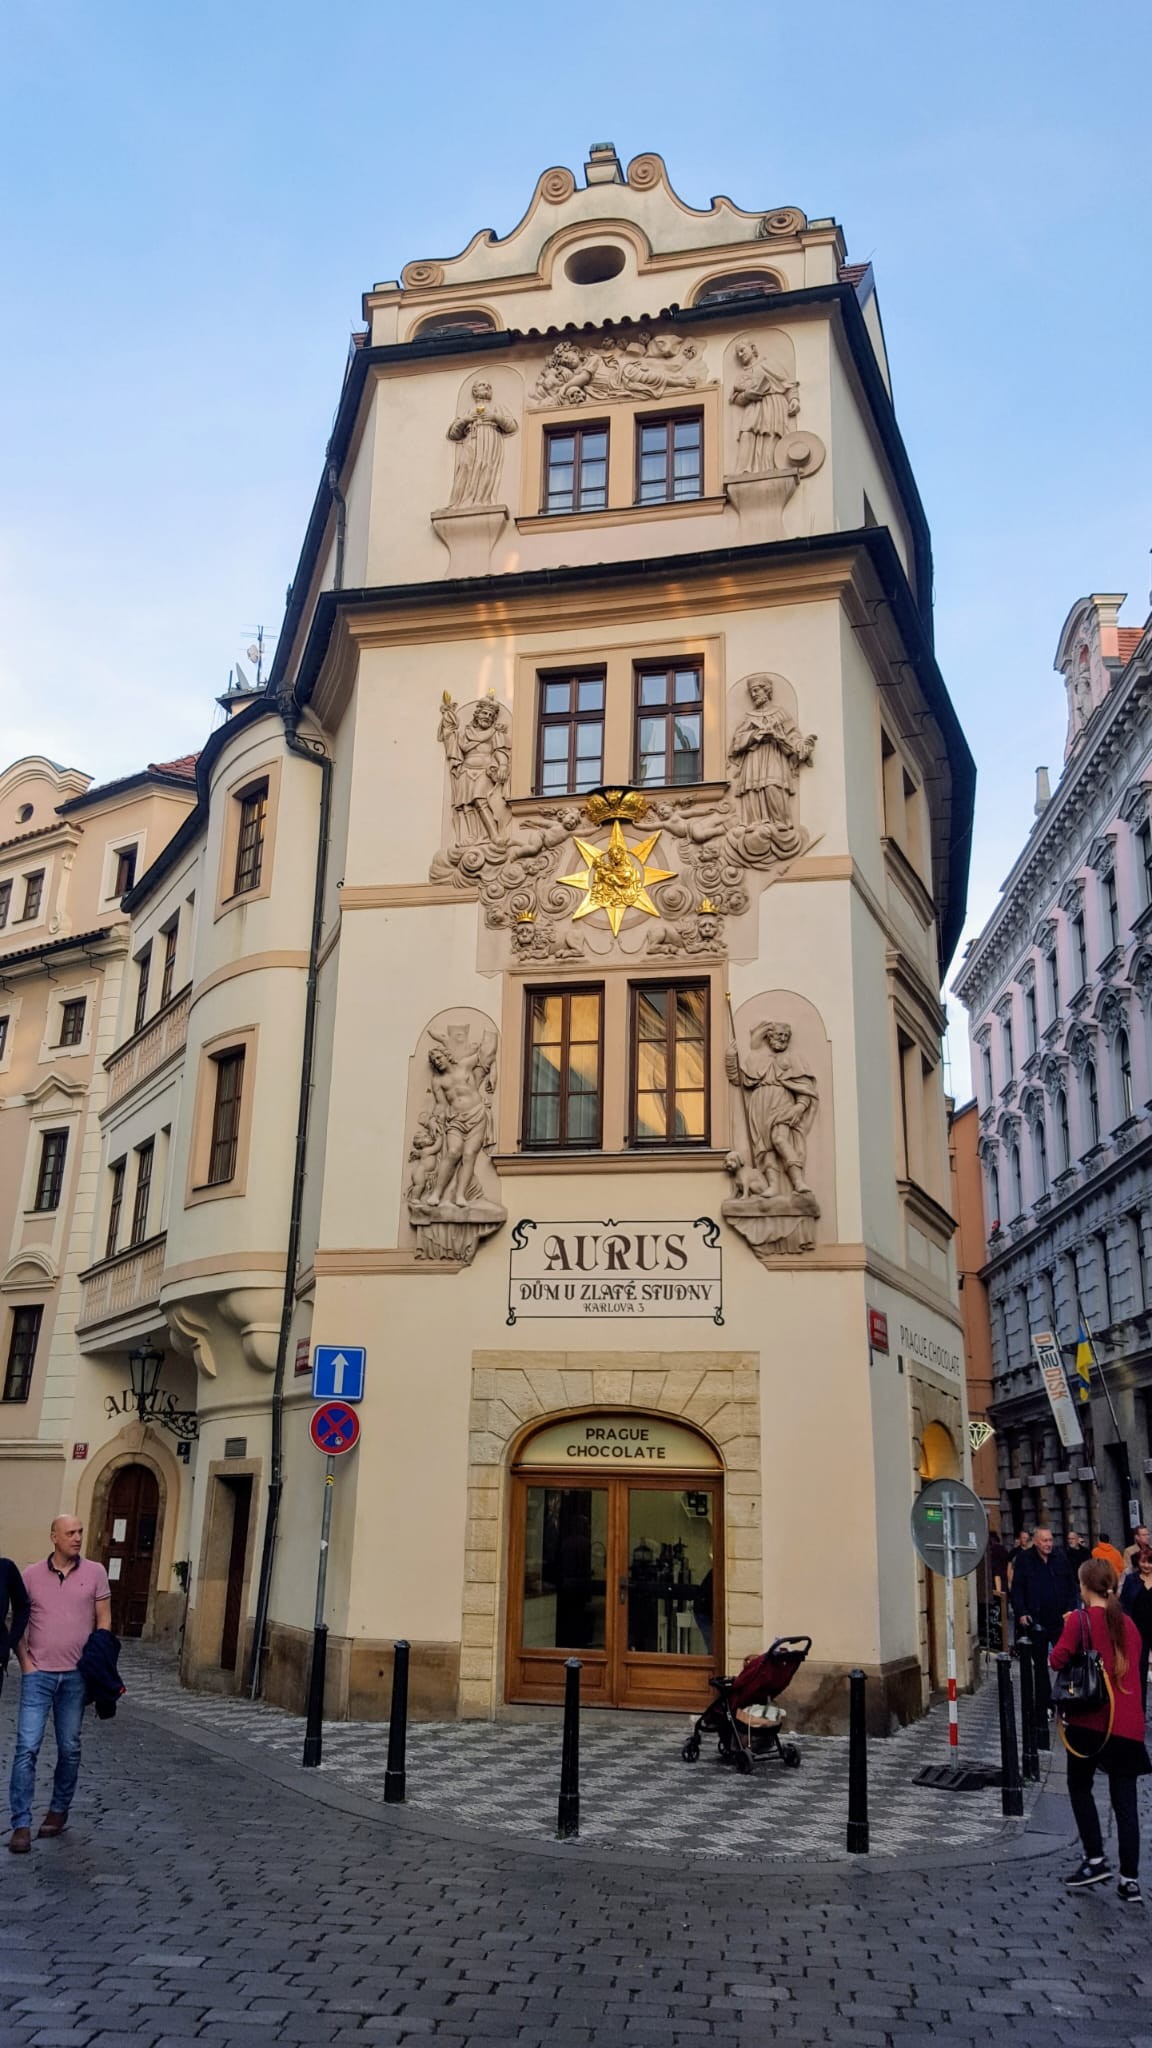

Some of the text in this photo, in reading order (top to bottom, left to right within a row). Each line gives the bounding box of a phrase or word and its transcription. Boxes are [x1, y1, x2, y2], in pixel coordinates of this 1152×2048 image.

[543, 1233, 688, 1272] AURUS
[519, 1280, 713, 1301] DŮM U ZLATÉ STUDNY
[583, 1302, 645, 1313] KARLOVA 3
[899, 1324, 928, 1359] PRAGUE
[928, 1341, 960, 1377] CHOCOLATE
[585, 1428, 649, 1441] PRAGUE
[566, 1445, 666, 1459] CHOCOLATE
